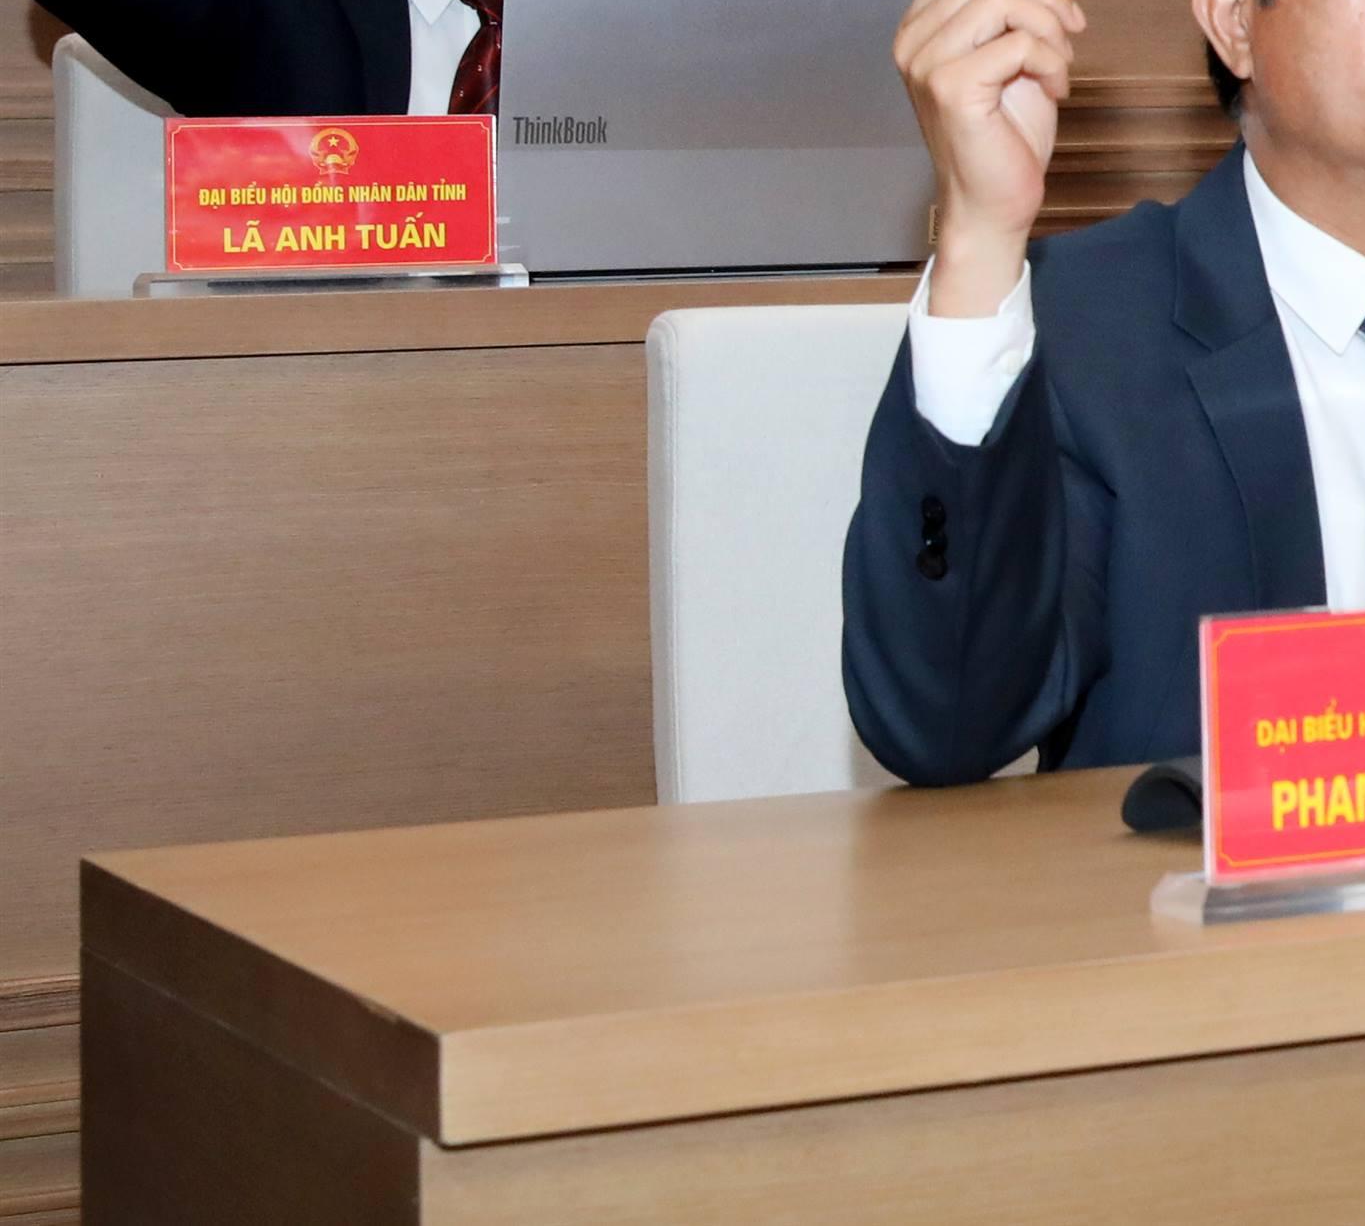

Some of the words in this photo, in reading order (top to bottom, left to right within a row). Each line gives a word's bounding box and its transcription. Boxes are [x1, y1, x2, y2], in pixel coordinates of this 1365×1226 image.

[513, 116, 607, 144] ThinkBook
[199, 188, 226, 209] ĐẠI
[231, 182, 266, 205] BIỂU
[271, 186, 297, 208] HỘI
[302, 182, 344, 204] ĐỒNG
[349, 182, 391, 202] NHÂN
[396, 181, 428, 201] DÂN
[431, 179, 466, 201] TỈNH
[223, 221, 265, 253] LÃ
[276, 225, 345, 251] ANH
[356, 212, 445, 249] TUẤN
